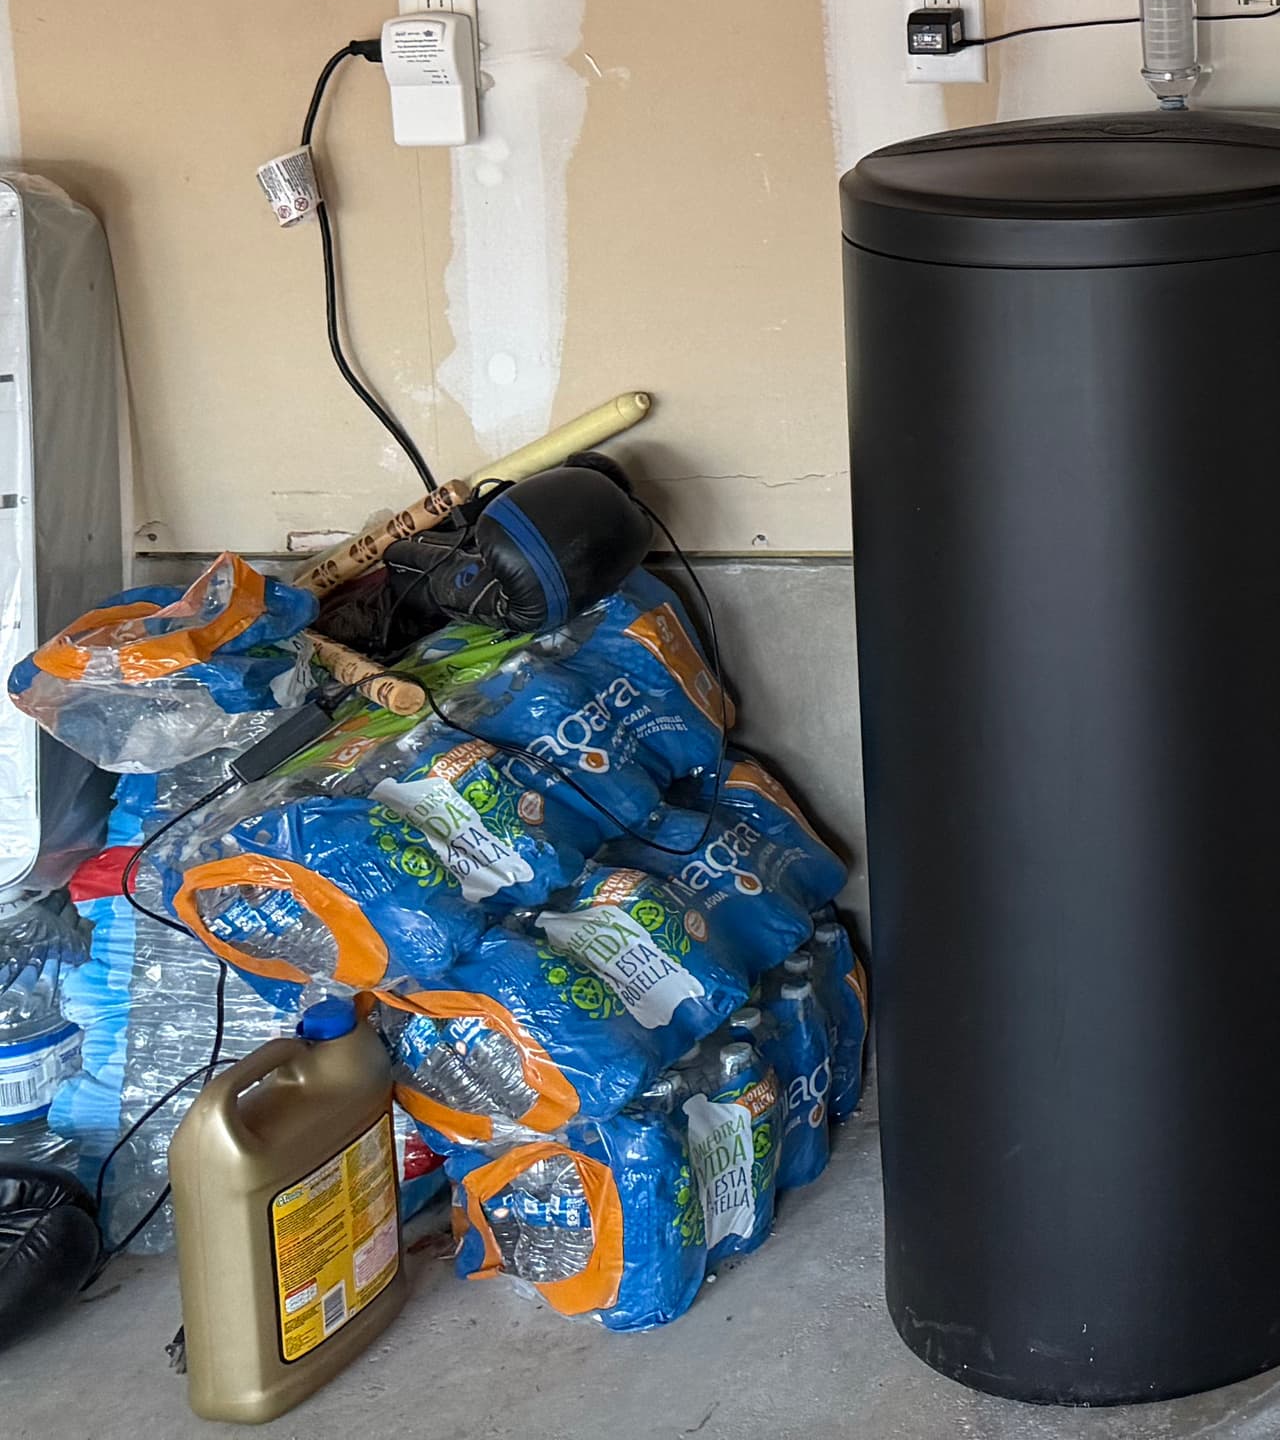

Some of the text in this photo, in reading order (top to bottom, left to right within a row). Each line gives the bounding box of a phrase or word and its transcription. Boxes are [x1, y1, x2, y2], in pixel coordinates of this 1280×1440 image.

[703, 891, 729, 910] AGUA
[615, 943, 658, 979] ESTA
[620, 958, 679, 1007] BOTELLA
[715, 1166, 749, 1197] ESTA
